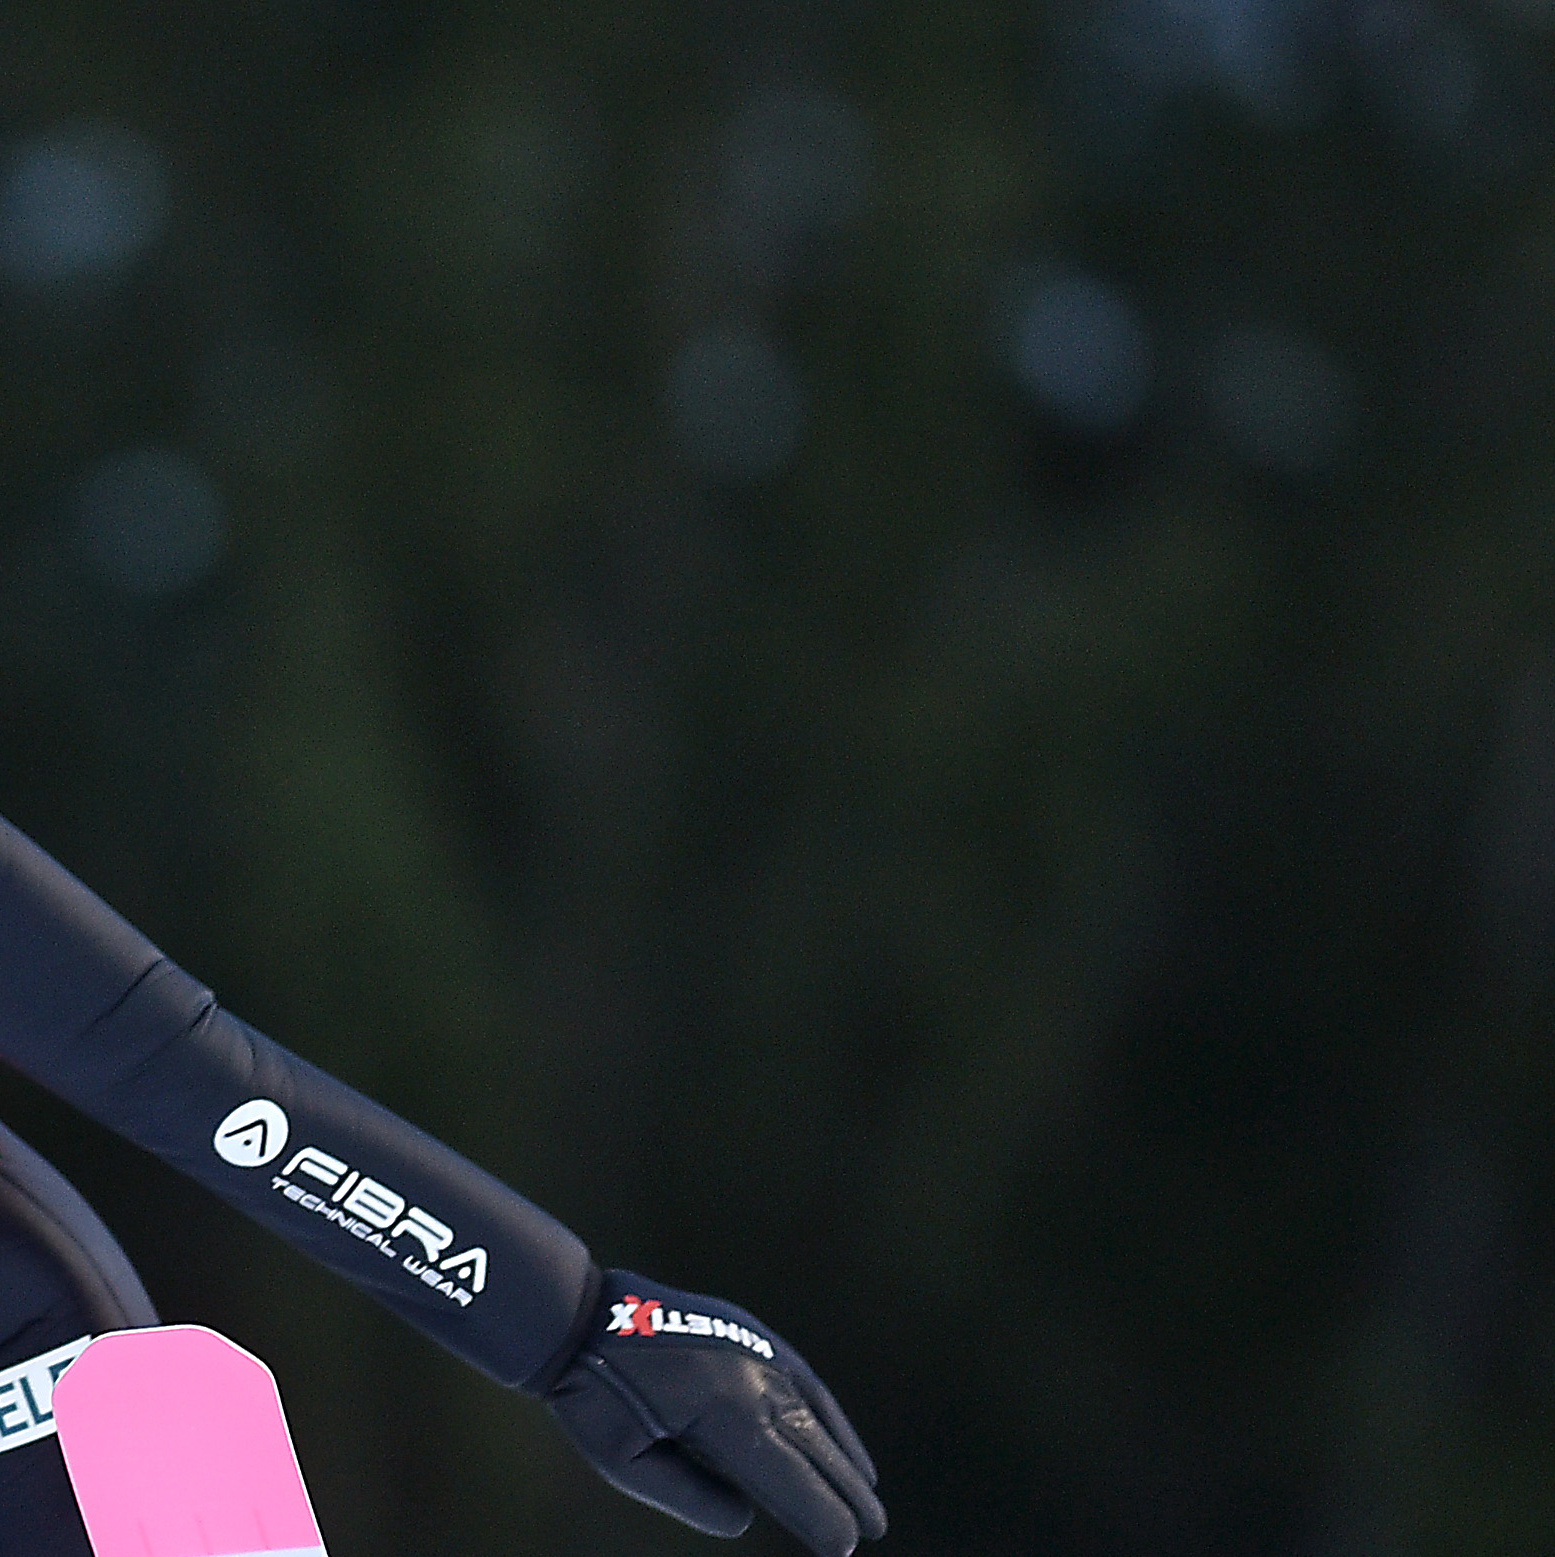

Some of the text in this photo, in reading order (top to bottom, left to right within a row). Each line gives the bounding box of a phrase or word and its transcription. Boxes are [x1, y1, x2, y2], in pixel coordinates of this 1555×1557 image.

[272, 1176, 473, 1308] TECHNICAL WEAR
[282, 1146, 488, 1293] FIBRA
